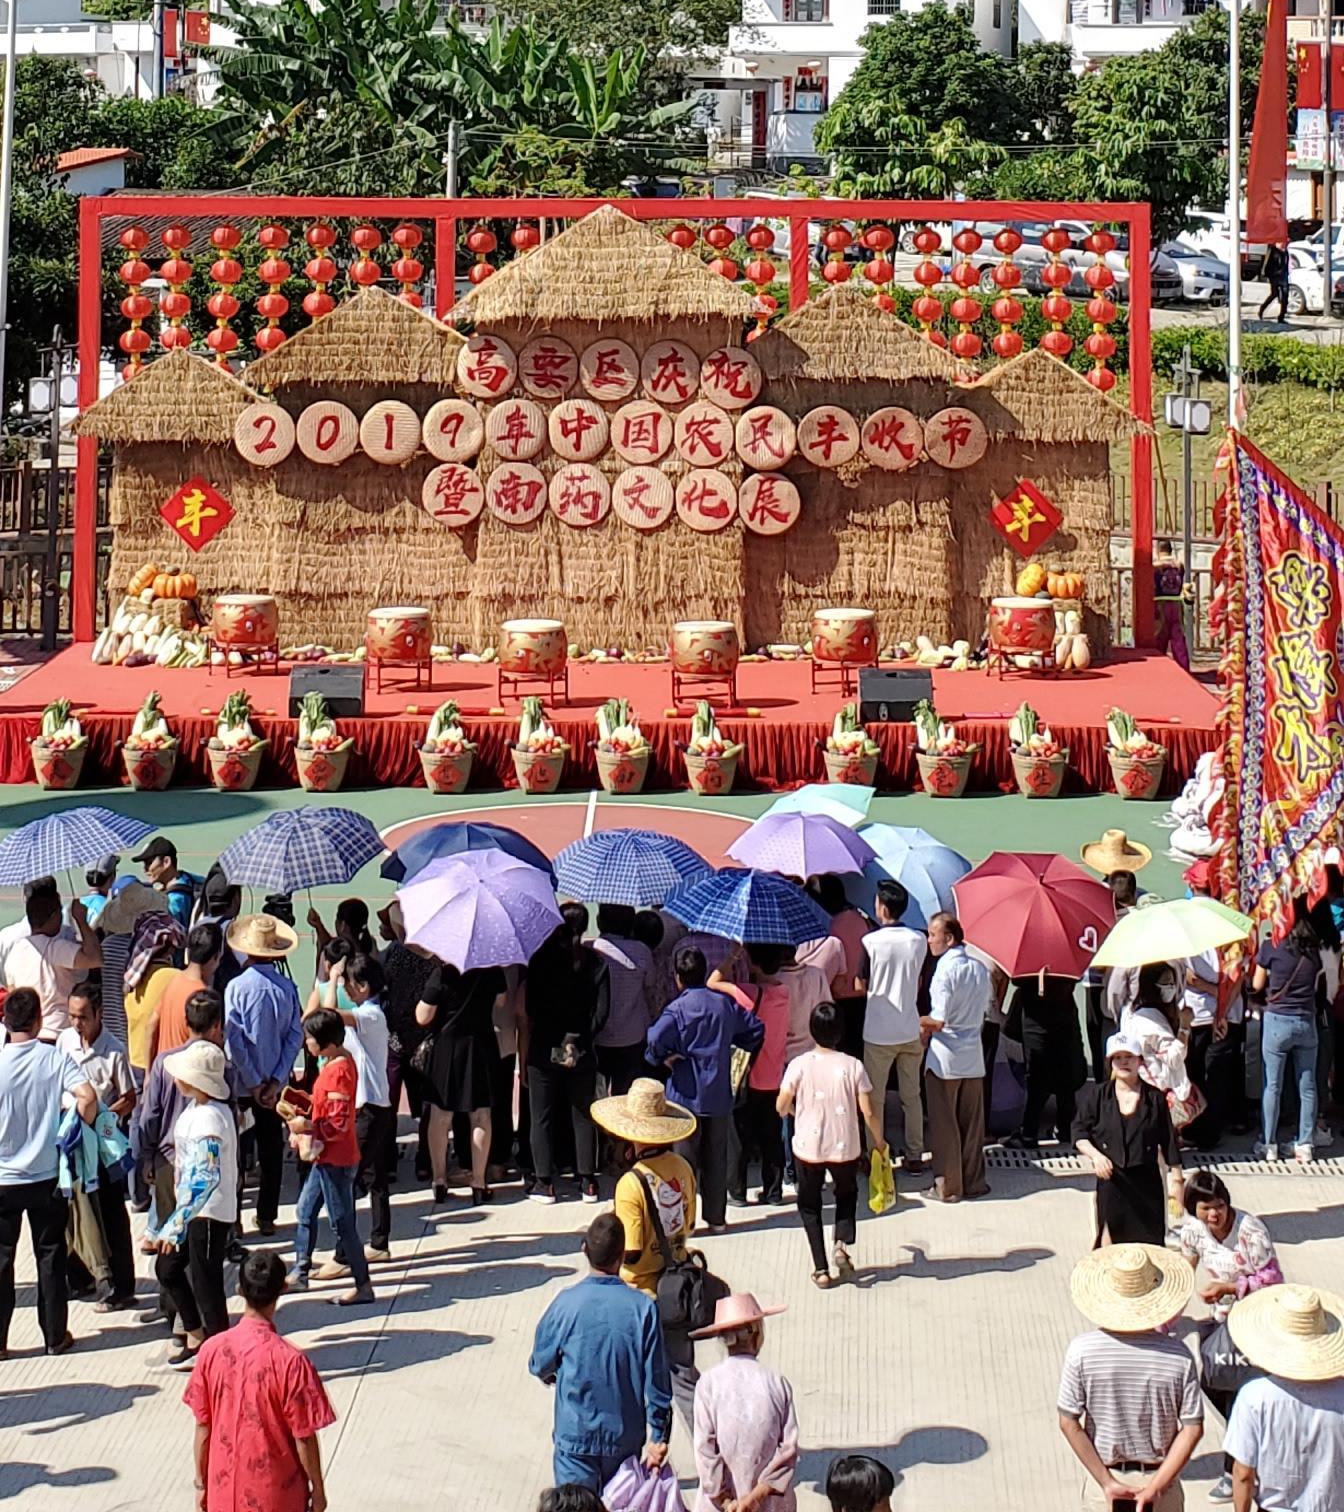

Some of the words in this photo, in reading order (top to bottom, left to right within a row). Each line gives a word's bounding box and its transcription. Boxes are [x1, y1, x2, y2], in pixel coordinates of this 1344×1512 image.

[467, 338, 753, 399] 高要区庆祝
[252, 405, 972, 461] 2019年中国农民丰收节
[176, 488, 218, 536] 丰
[434, 465, 789, 525] 暨南药文化展
